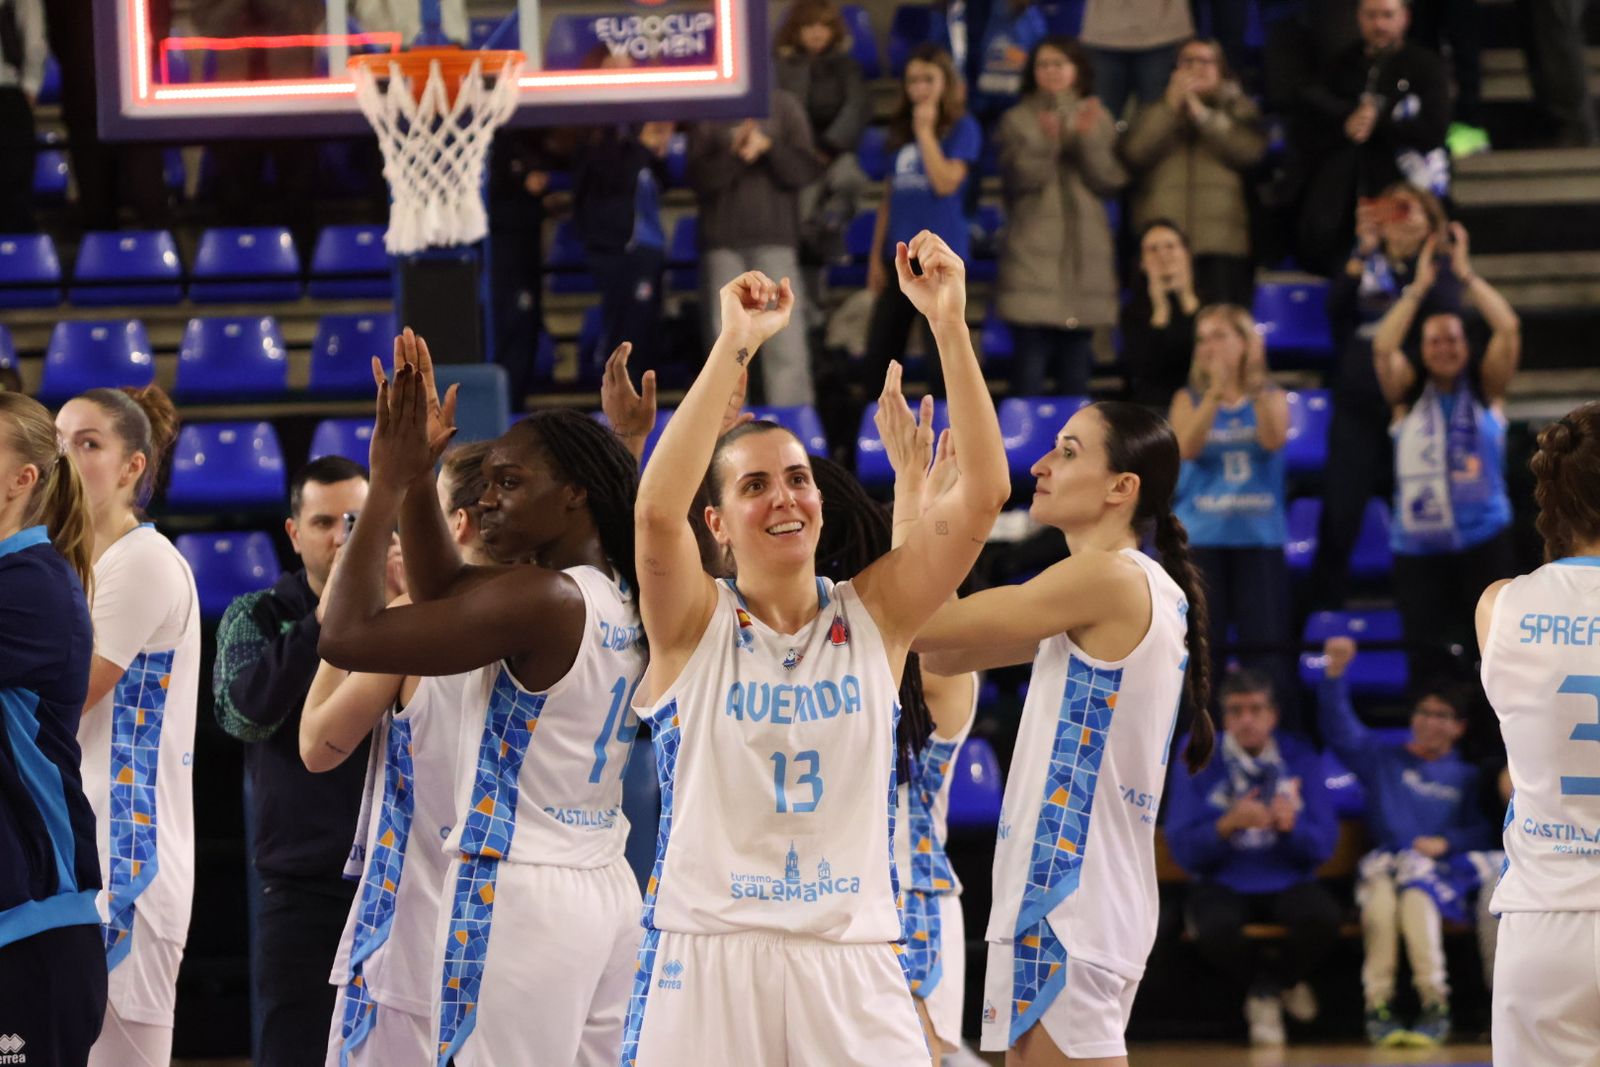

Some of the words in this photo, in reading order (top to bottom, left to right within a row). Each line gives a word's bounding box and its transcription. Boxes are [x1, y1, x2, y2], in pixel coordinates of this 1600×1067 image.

[595, 12, 716, 41] EUROCUP
[605, 33, 706, 59] WOMEN
[769, 750, 824, 813] 13
[730, 871, 772, 883] turismo
[658, 978, 683, 990] errea
